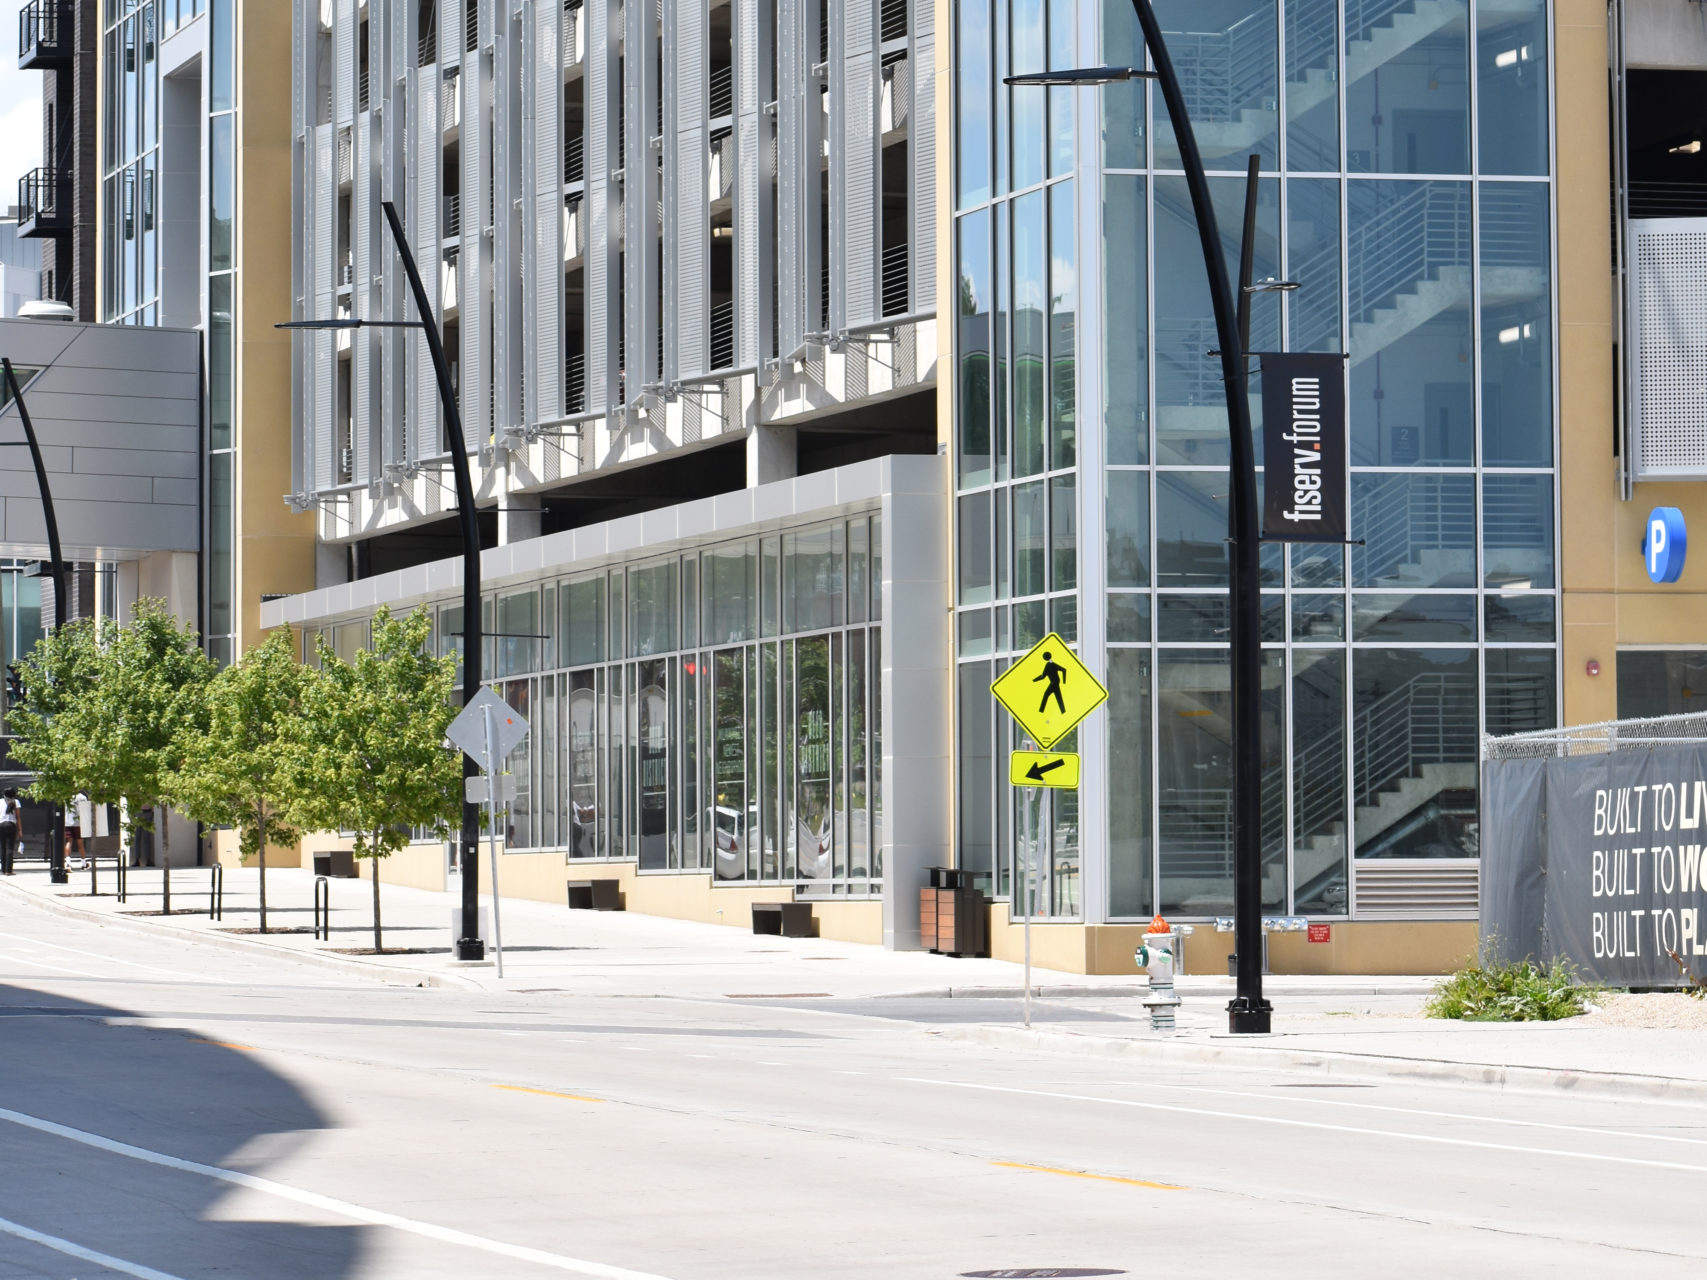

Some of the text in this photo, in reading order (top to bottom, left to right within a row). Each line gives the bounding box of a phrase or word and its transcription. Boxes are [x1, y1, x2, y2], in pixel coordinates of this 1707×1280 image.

[1283, 377, 1322, 522] fiserv.forum
[1400, 428, 1409, 440] 2
[1651, 519, 1666, 573] P
[1593, 785, 1647, 836] BUILT
[1652, 782, 1675, 831] TO
[1592, 848, 1646, 897] BUILT
[1651, 845, 1675, 894] TO
[1592, 907, 1707, 959] BUILT TO PL
